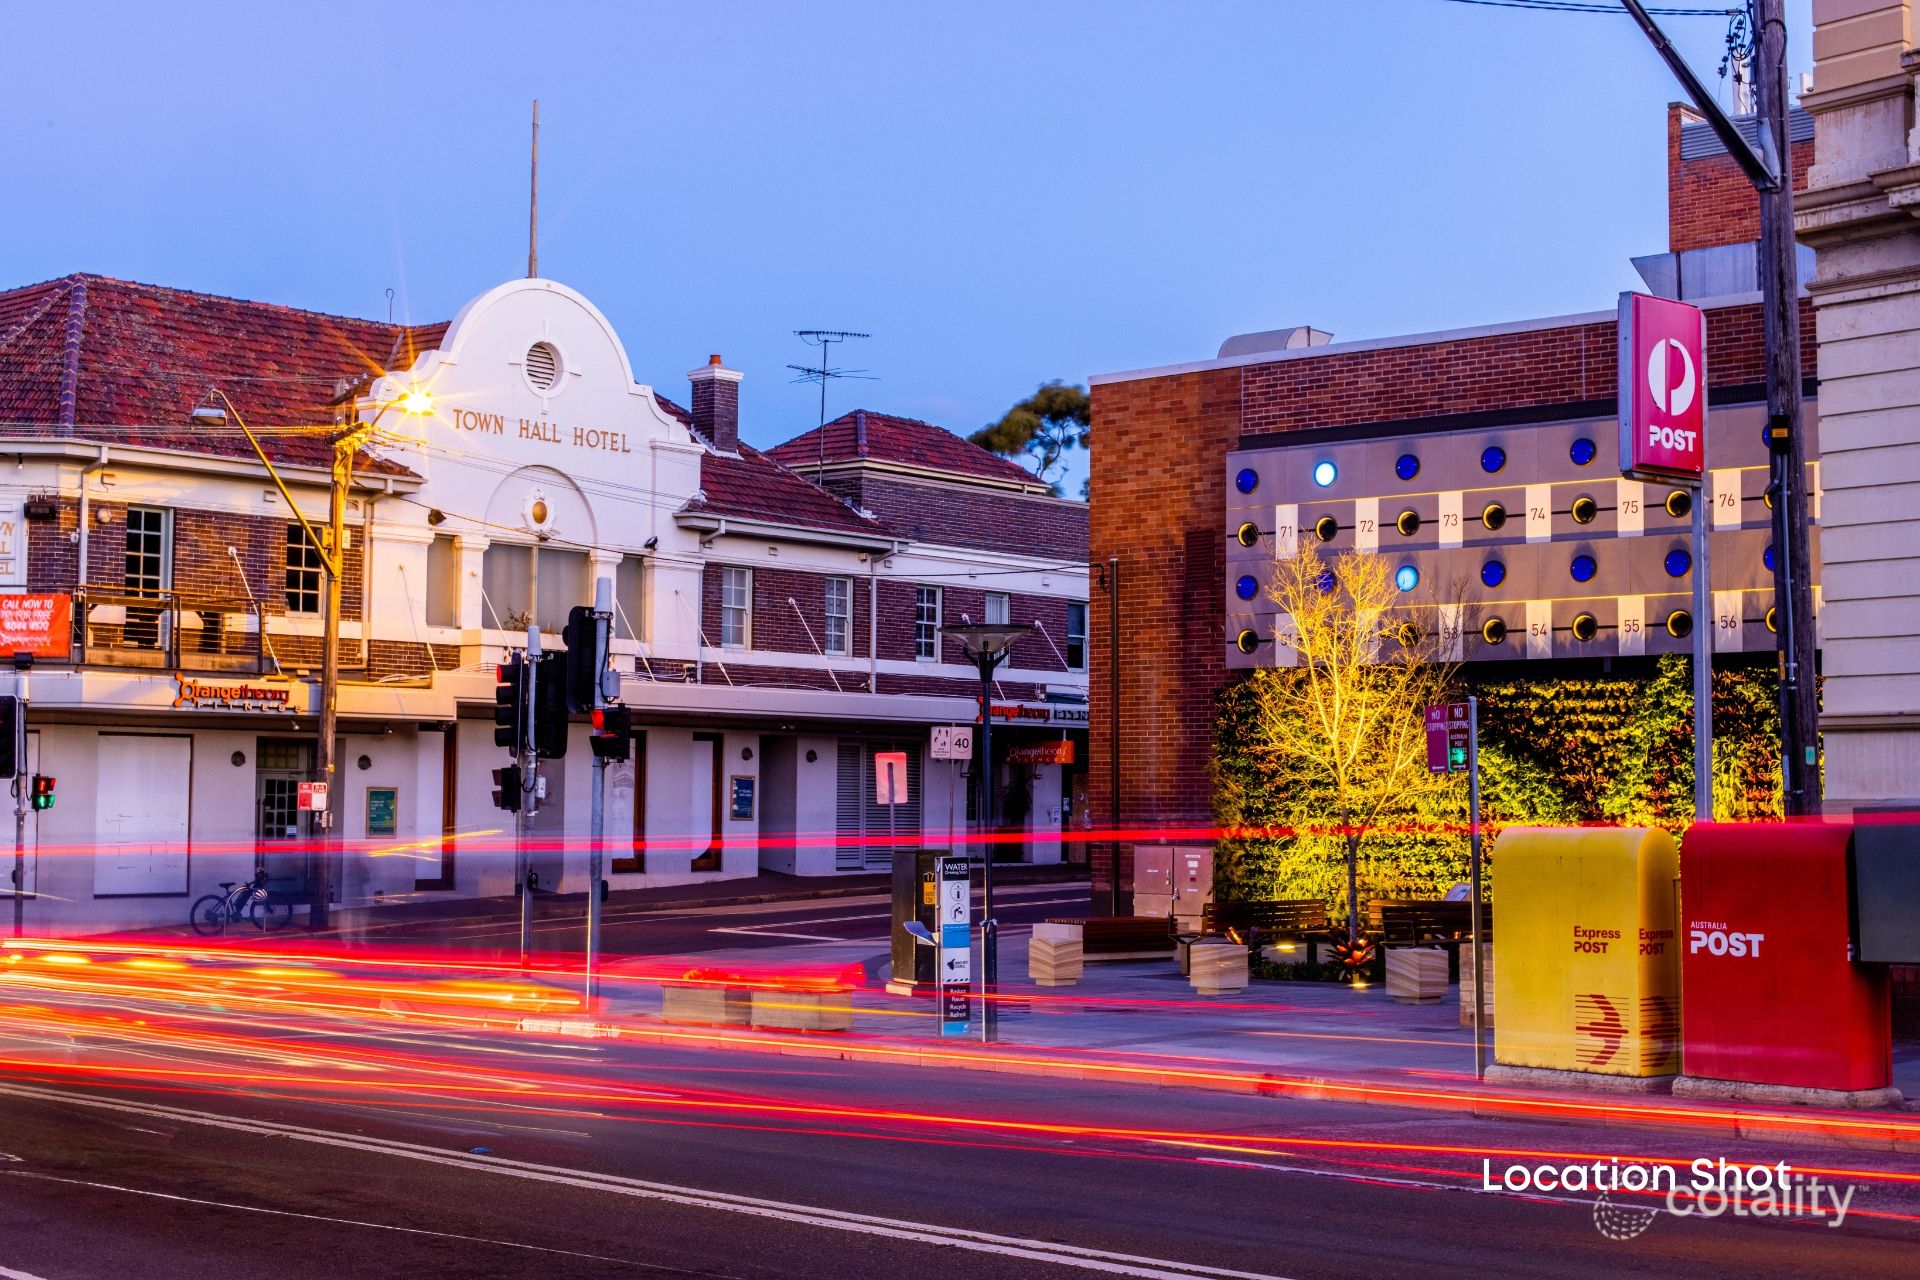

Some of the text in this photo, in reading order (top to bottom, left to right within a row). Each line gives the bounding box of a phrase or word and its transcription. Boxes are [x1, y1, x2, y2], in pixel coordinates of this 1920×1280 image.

[453, 408, 631, 452] TOWN HALL HOTEL
[1649, 425, 1697, 452] POST
[1719, 494, 1735, 507] 76
[1623, 501, 1639, 514] 75
[1443, 514, 1458, 527] 73
[1530, 508, 1545, 521] 74
[1280, 526, 1293, 539] 71
[1360, 520, 1374, 533] 72
[2, 599, 54, 609] CALL NOW TO
[1624, 619, 1640, 632] 55
[1720, 616, 1736, 629] 56
[1443, 627, 1458, 640] 53
[1531, 623, 1547, 636] 54
[197, 701, 302, 713] FITNESS
[1454, 707, 1463, 718] NO
[1431, 709, 1440, 719] NO
[1449, 720, 1469, 729] STOPPING
[954, 737, 969, 749] 40
[944, 863, 968, 871] WATER
[1690, 921, 1727, 930] AUSTRALIA
[1574, 925, 1620, 940] Express
[1639, 928, 1674, 942] Express
[1574, 941, 1608, 954] POST
[1639, 942, 1665, 955] POST
[1690, 930, 1764, 958] POST
